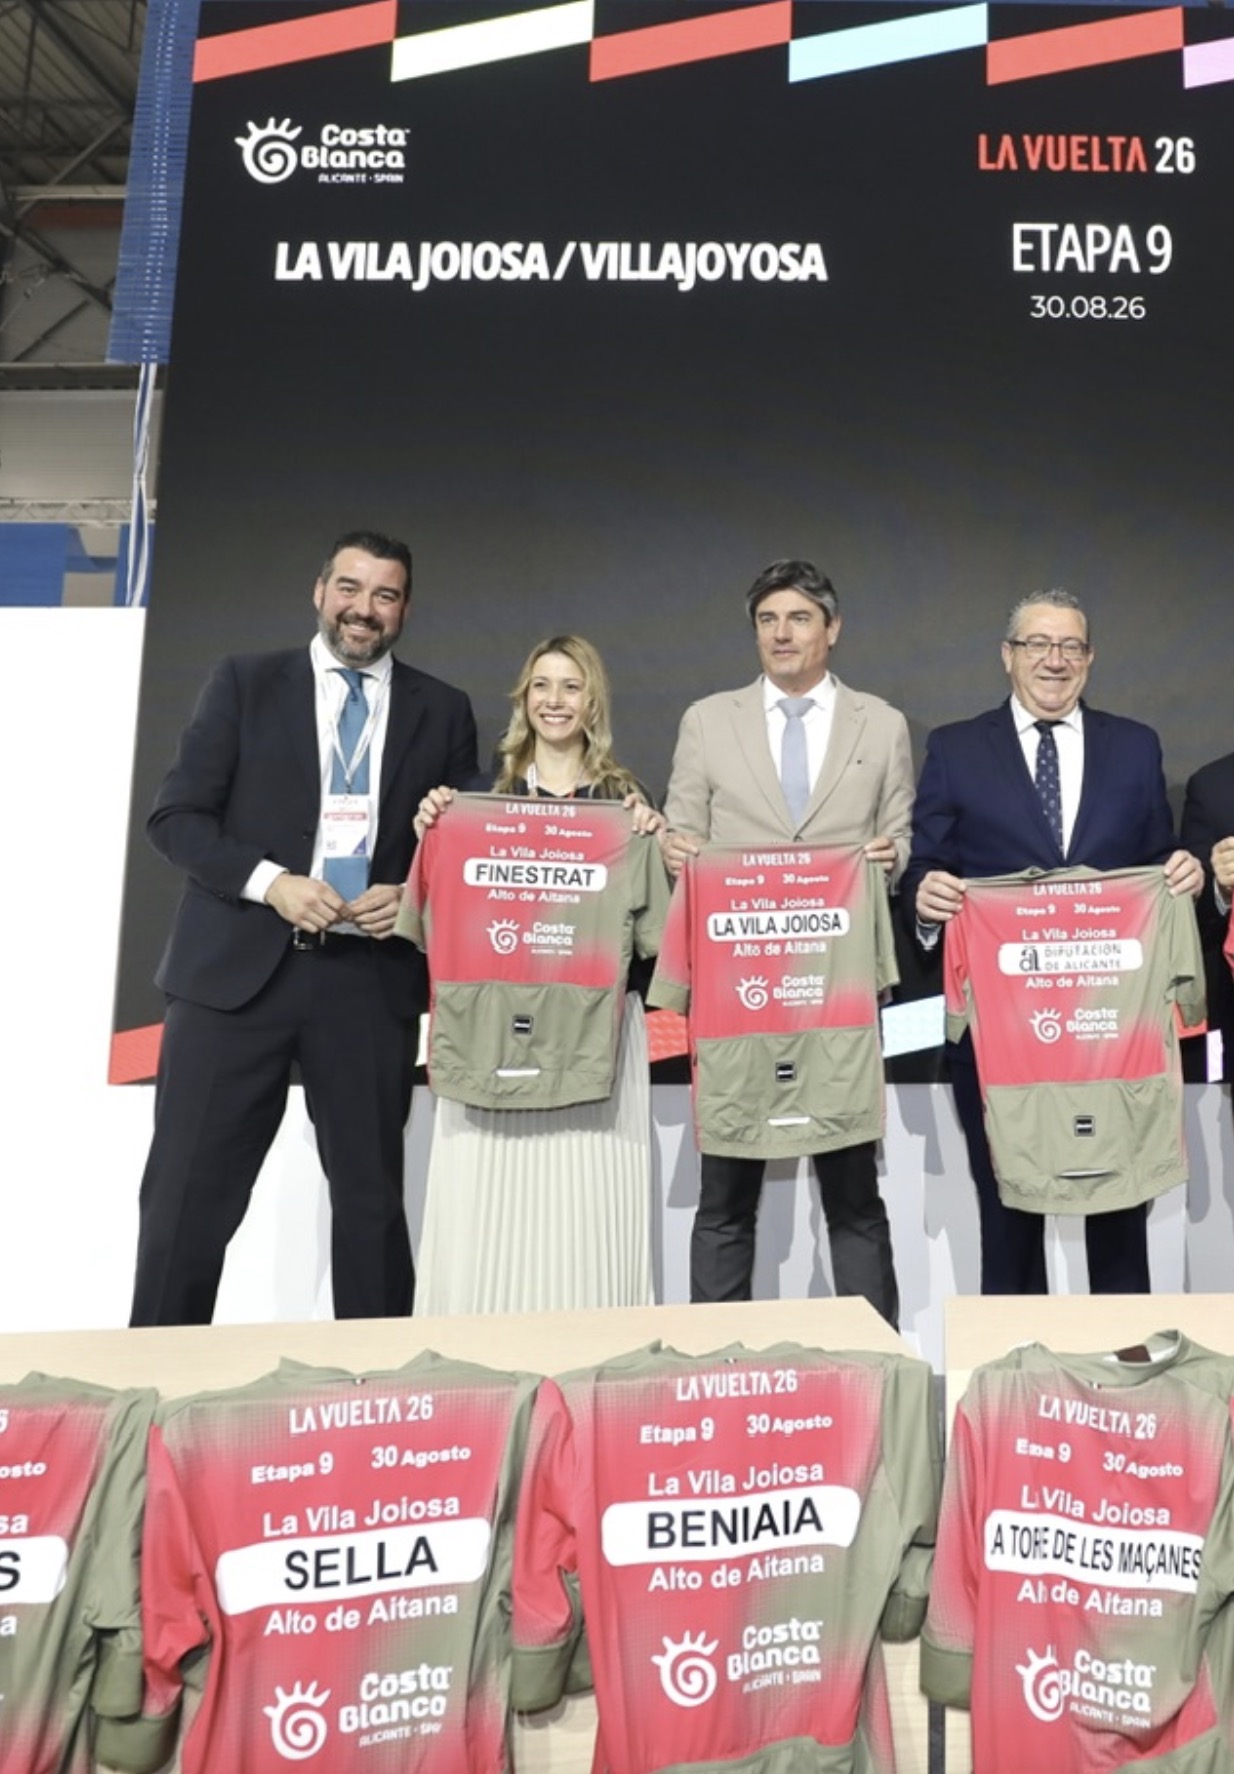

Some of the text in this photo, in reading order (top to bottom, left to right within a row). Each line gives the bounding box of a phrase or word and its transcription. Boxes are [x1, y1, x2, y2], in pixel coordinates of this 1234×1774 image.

[321, 124, 406, 147] Costa
[301, 147, 405, 168] Blanca
[978, 134, 1195, 174] LA VUELTA 26
[318, 173, 403, 183] ALICANTE SPAIN
[1013, 223, 1172, 274] ETAPA 9
[275, 242, 828, 292] LA VILA JOIOSA / VILLAJOYOSA
[1030, 295, 1146, 319] 30.08.26
[490, 846, 584, 860] La Vila Joiosa
[476, 864, 595, 887] FINESTRAT
[488, 890, 580, 904] Alto de Aitana
[522, 933, 573, 946] Blanca
[532, 922, 574, 934] Costa
[714, 913, 842, 936] LA VILA JOIOSA
[1045, 959, 1121, 970] DE ALICANTE
[774, 987, 824, 998] Blanca
[782, 976, 824, 986] Costa
[677, 1370, 798, 1400] LA VUELTA 26
[290, 1395, 433, 1434] LA VUELTA 26
[747, 1414, 833, 1435] 30 Agosto
[1038, 1395, 1156, 1439] LA VUELTA 26
[641, 1418, 714, 1445] Etapa 9
[252, 1451, 333, 1484] Etapa 9
[371, 1445, 471, 1468] 30 Agosto
[1103, 1451, 1183, 1478] 30 Agosto
[649, 1464, 824, 1496] La Vila Joiosa
[264, 1496, 459, 1537] La Vila Joiosa
[648, 1497, 823, 1549] BENIAIA
[285, 1536, 438, 1591] SELLA
[1053, 1531, 1076, 1564] DE
[1081, 1537, 1114, 1572] LES
[1118, 1543, 1203, 1582] MAÇANES
[648, 1554, 824, 1591] Alto de Aitana
[264, 1594, 458, 1635] Alto de Aitana
[743, 1618, 819, 1650] Costa
[727, 1644, 821, 1681] Blanca
[1073, 1650, 1152, 1688] Costa
[360, 1663, 449, 1702] Costa
[1059, 1670, 1151, 1713] Blanca
